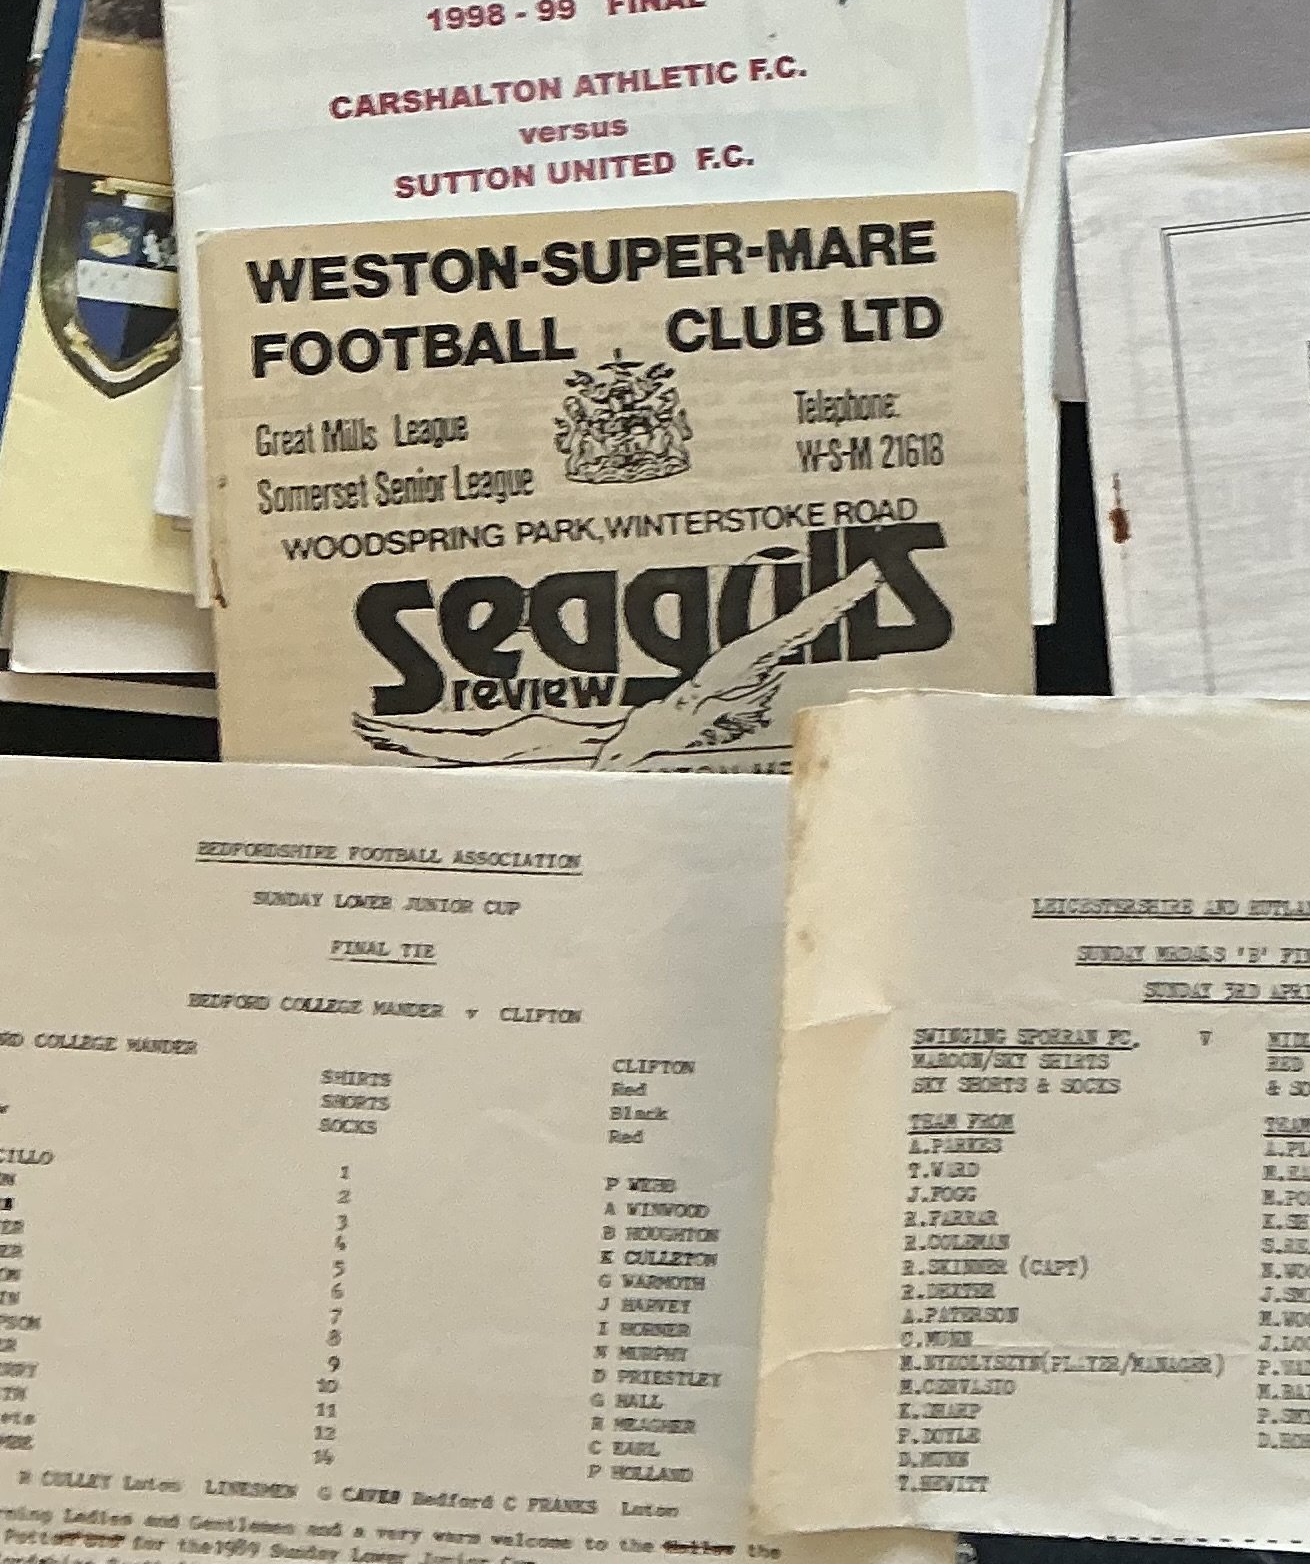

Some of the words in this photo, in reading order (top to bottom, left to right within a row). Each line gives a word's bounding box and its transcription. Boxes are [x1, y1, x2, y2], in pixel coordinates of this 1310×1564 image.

[426, 3, 506, 32] 1998
[328, 76, 562, 120] CARSHALTON
[573, 60, 739, 98] ATHLETIC
[748, 55, 807, 82] F.C.
[518, 118, 629, 145] versus
[394, 163, 536, 199] SUTTON
[547, 151, 677, 185] UNITED
[696, 144, 755, 171] F.C.
[247, 221, 937, 304] WESTON-SUPER-MARE
[251, 317, 578, 379] FOOTBALL
[666, 300, 825, 354] CLUB
[842, 296, 944, 344] LTD
[256, 422, 317, 457] Great
[320, 417, 378, 453] Mills
[394, 415, 470, 449] League
[795, 436, 874, 473] W-S-M
[879, 431, 944, 469] 21618
[256, 474, 369, 516] Somerset
[374, 471, 448, 508] Senior
[452, 466, 535, 504] League
[280, 523, 505, 561] WOODSPRING
[833, 497, 918, 525] ROAD
[452, 674, 619, 712] review
[196, 841, 338, 860] BEDFORDSHIRE
[348, 846, 443, 865] FOOTBALL
[452, 849, 582, 869] ASSOCIATION
[252, 891, 324, 908] SUNDAY
[333, 893, 393, 911] LOWER
[402, 897, 475, 914] JUNIOR
[483, 899, 521, 916] CUP
[330, 939, 391, 957] FINAL
[400, 943, 436, 959] TIE
[612, 1058, 696, 1075] CLIFTON
[610, 1082, 648, 1097] Red
[608, 1105, 669, 1121] Black
[608, 1129, 644, 1144] Red
